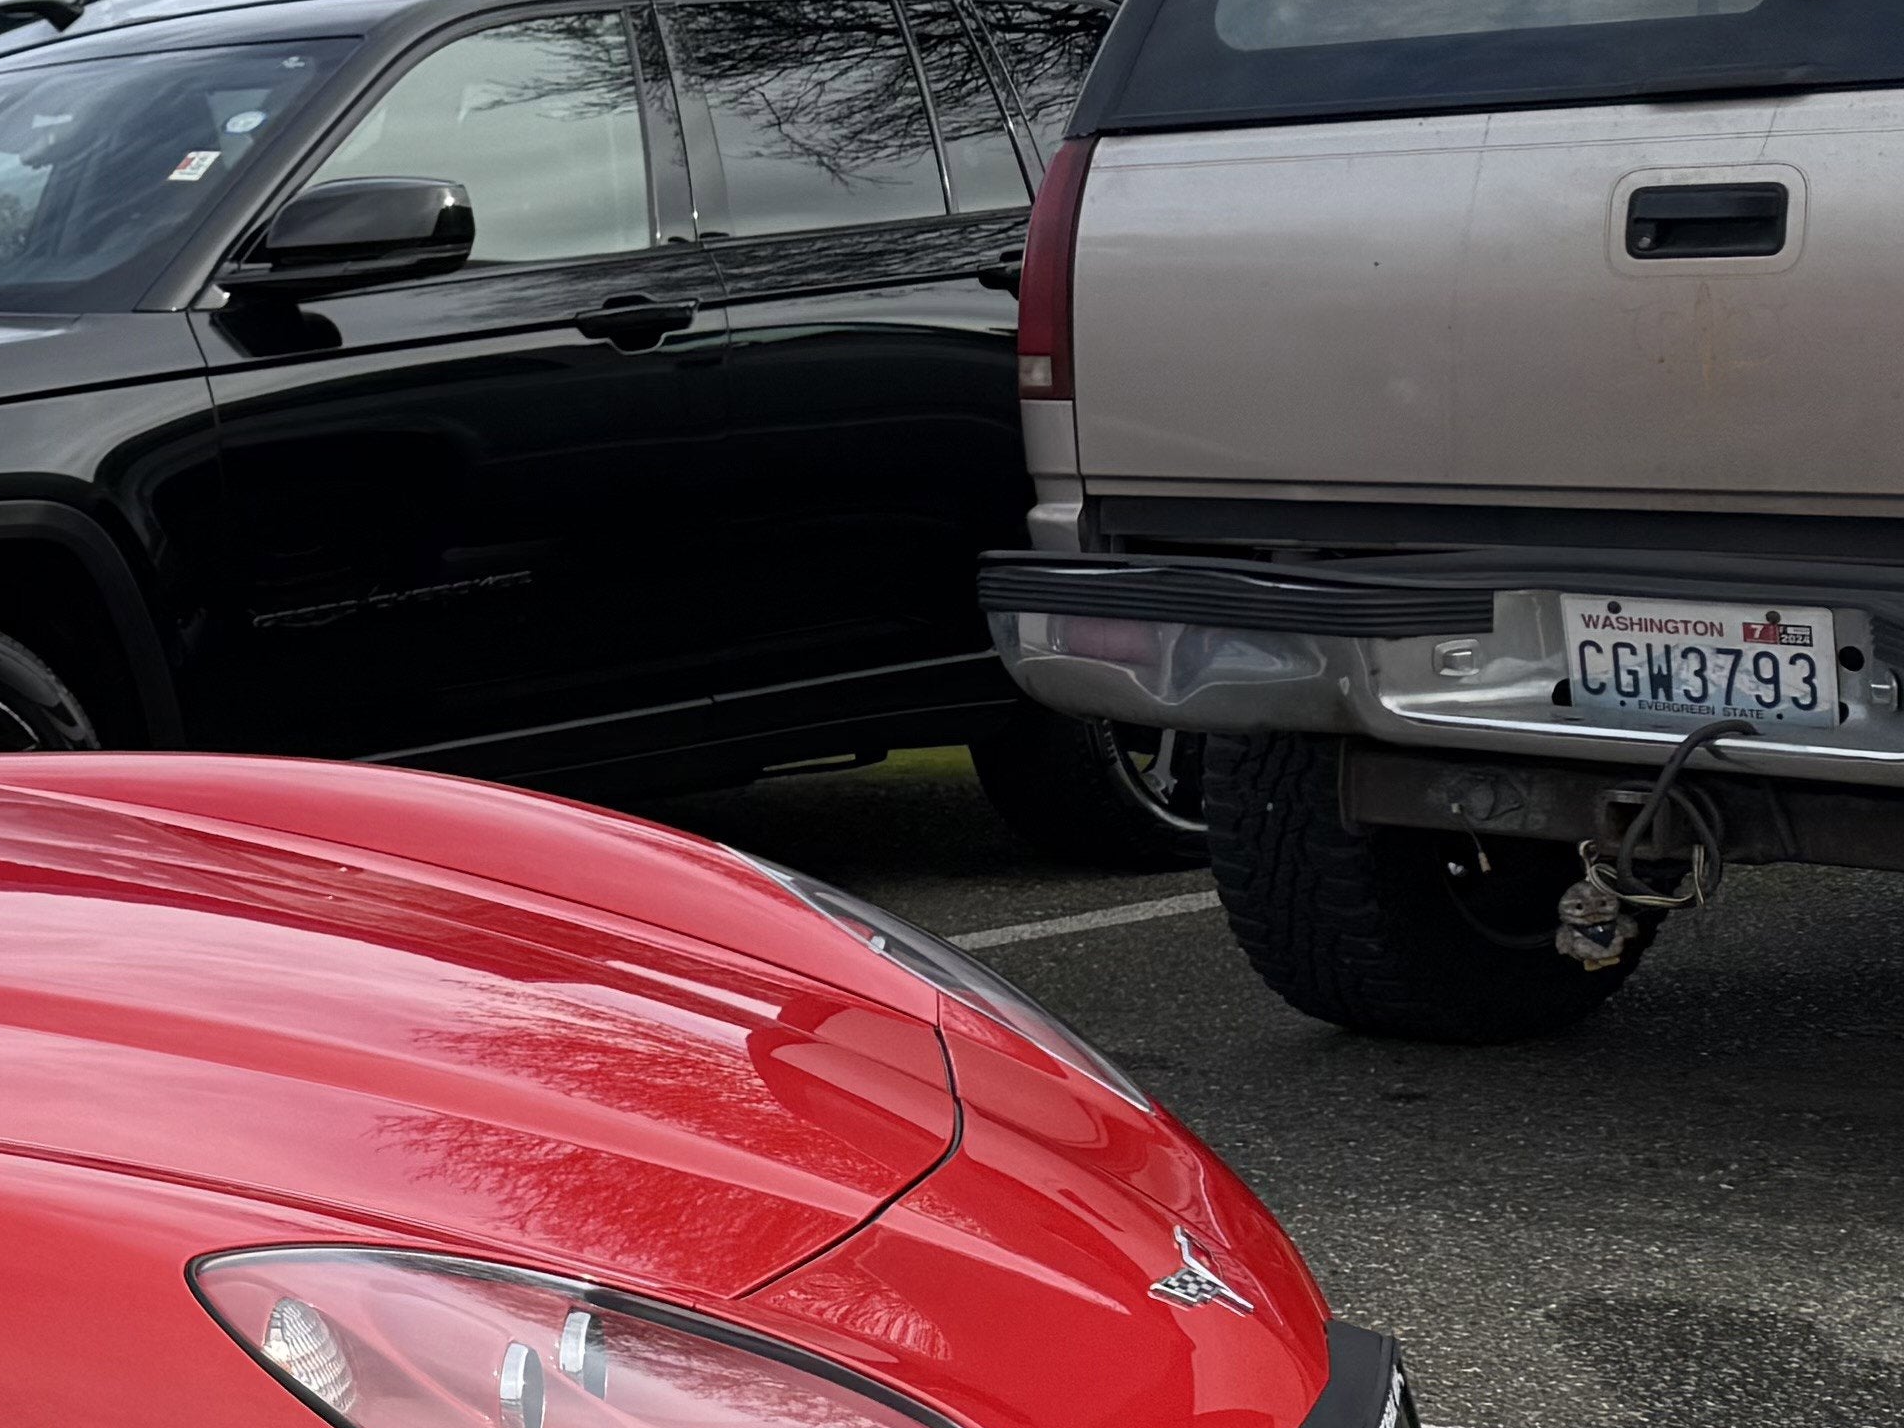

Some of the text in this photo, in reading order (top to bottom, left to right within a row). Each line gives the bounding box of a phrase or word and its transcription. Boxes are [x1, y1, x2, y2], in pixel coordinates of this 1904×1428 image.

[1581, 613, 1724, 638] WASHINGTON
[1750, 624, 1765, 639] 7
[1578, 640, 1818, 711] CGW3793
[1638, 699, 1765, 720] EVERGREEN STATE
